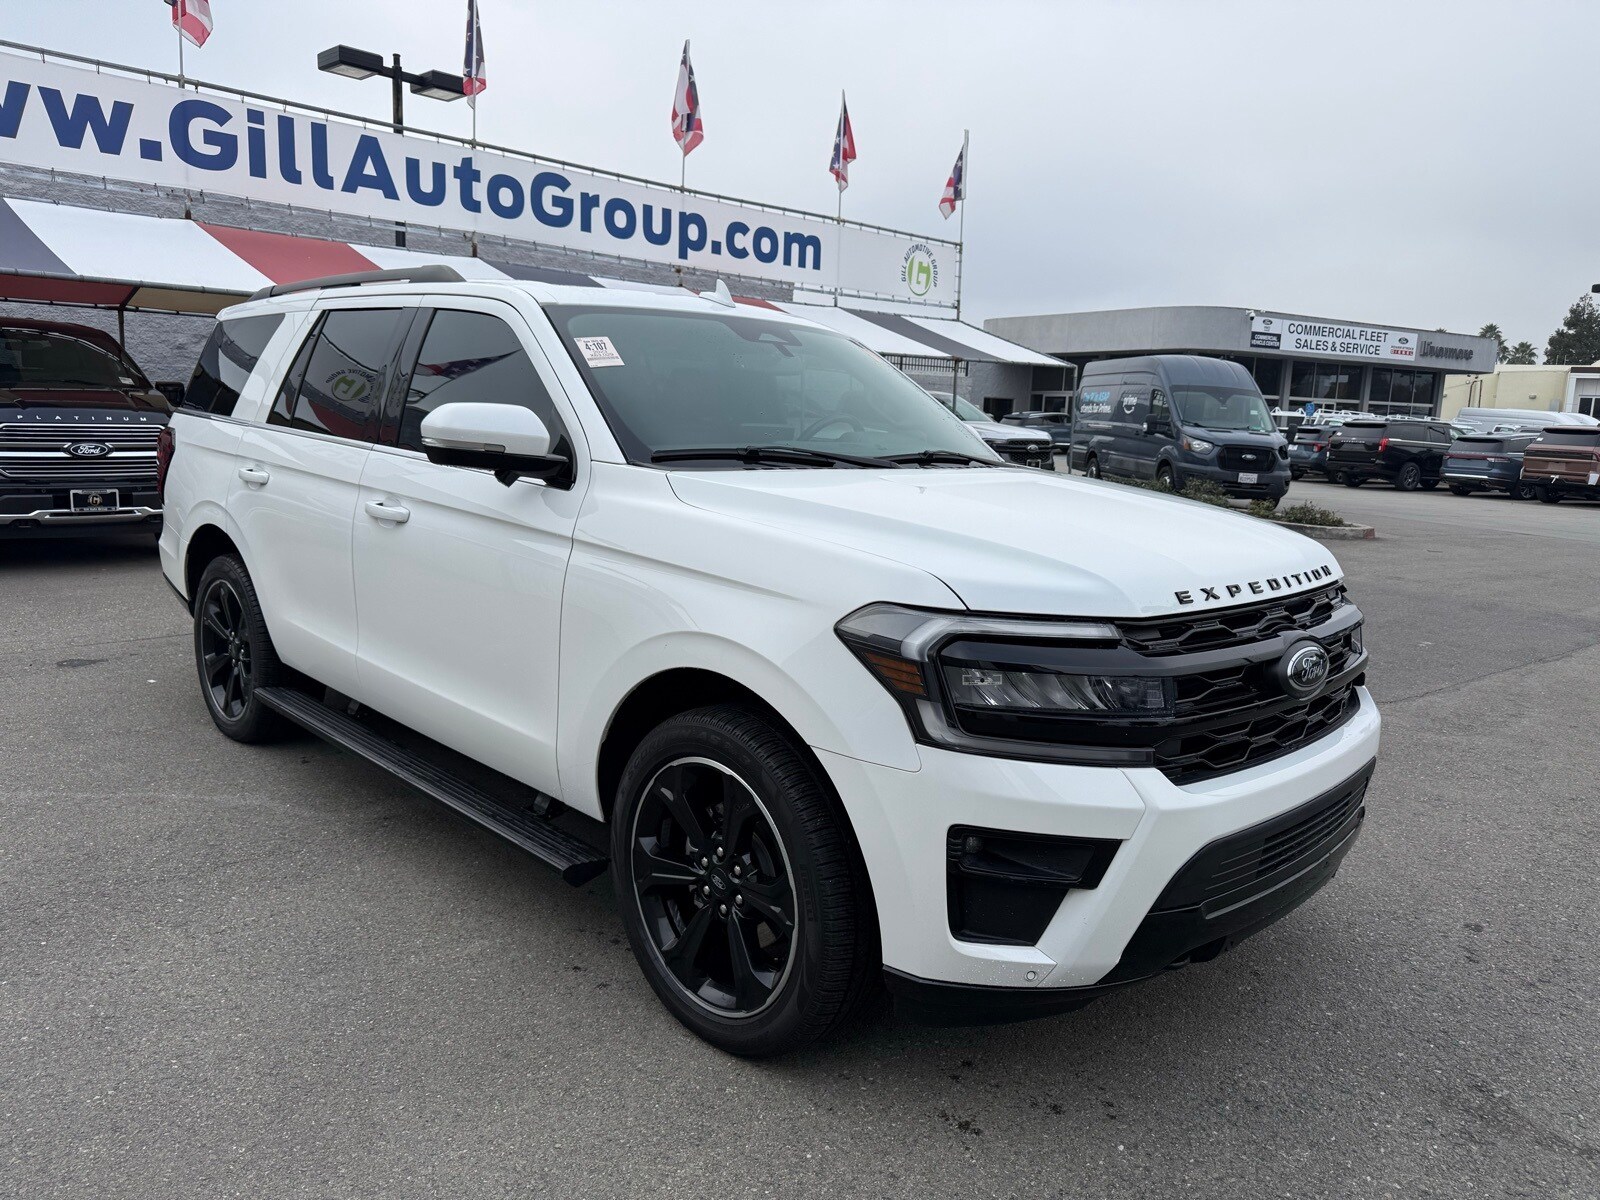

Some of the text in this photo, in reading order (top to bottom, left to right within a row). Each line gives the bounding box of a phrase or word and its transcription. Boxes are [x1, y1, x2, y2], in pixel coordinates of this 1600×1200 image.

[904, 243, 934, 264] AUTOMOTIVE
[931, 259, 939, 288] GROUP
[1254, 334, 1278, 342] COMMERCIAL
[1288, 323, 1389, 343] COMMERCIAL FLEET
[1294, 338, 1380, 356] SALES & SERVICE
[1420, 340, 1474, 360] Livermore
[17, 414, 147, 422] PLATINUM
[77, 445, 101, 455] Ford
[1174, 564, 1333, 605] EXPEDITION
[1301, 656, 1325, 682] Ford
